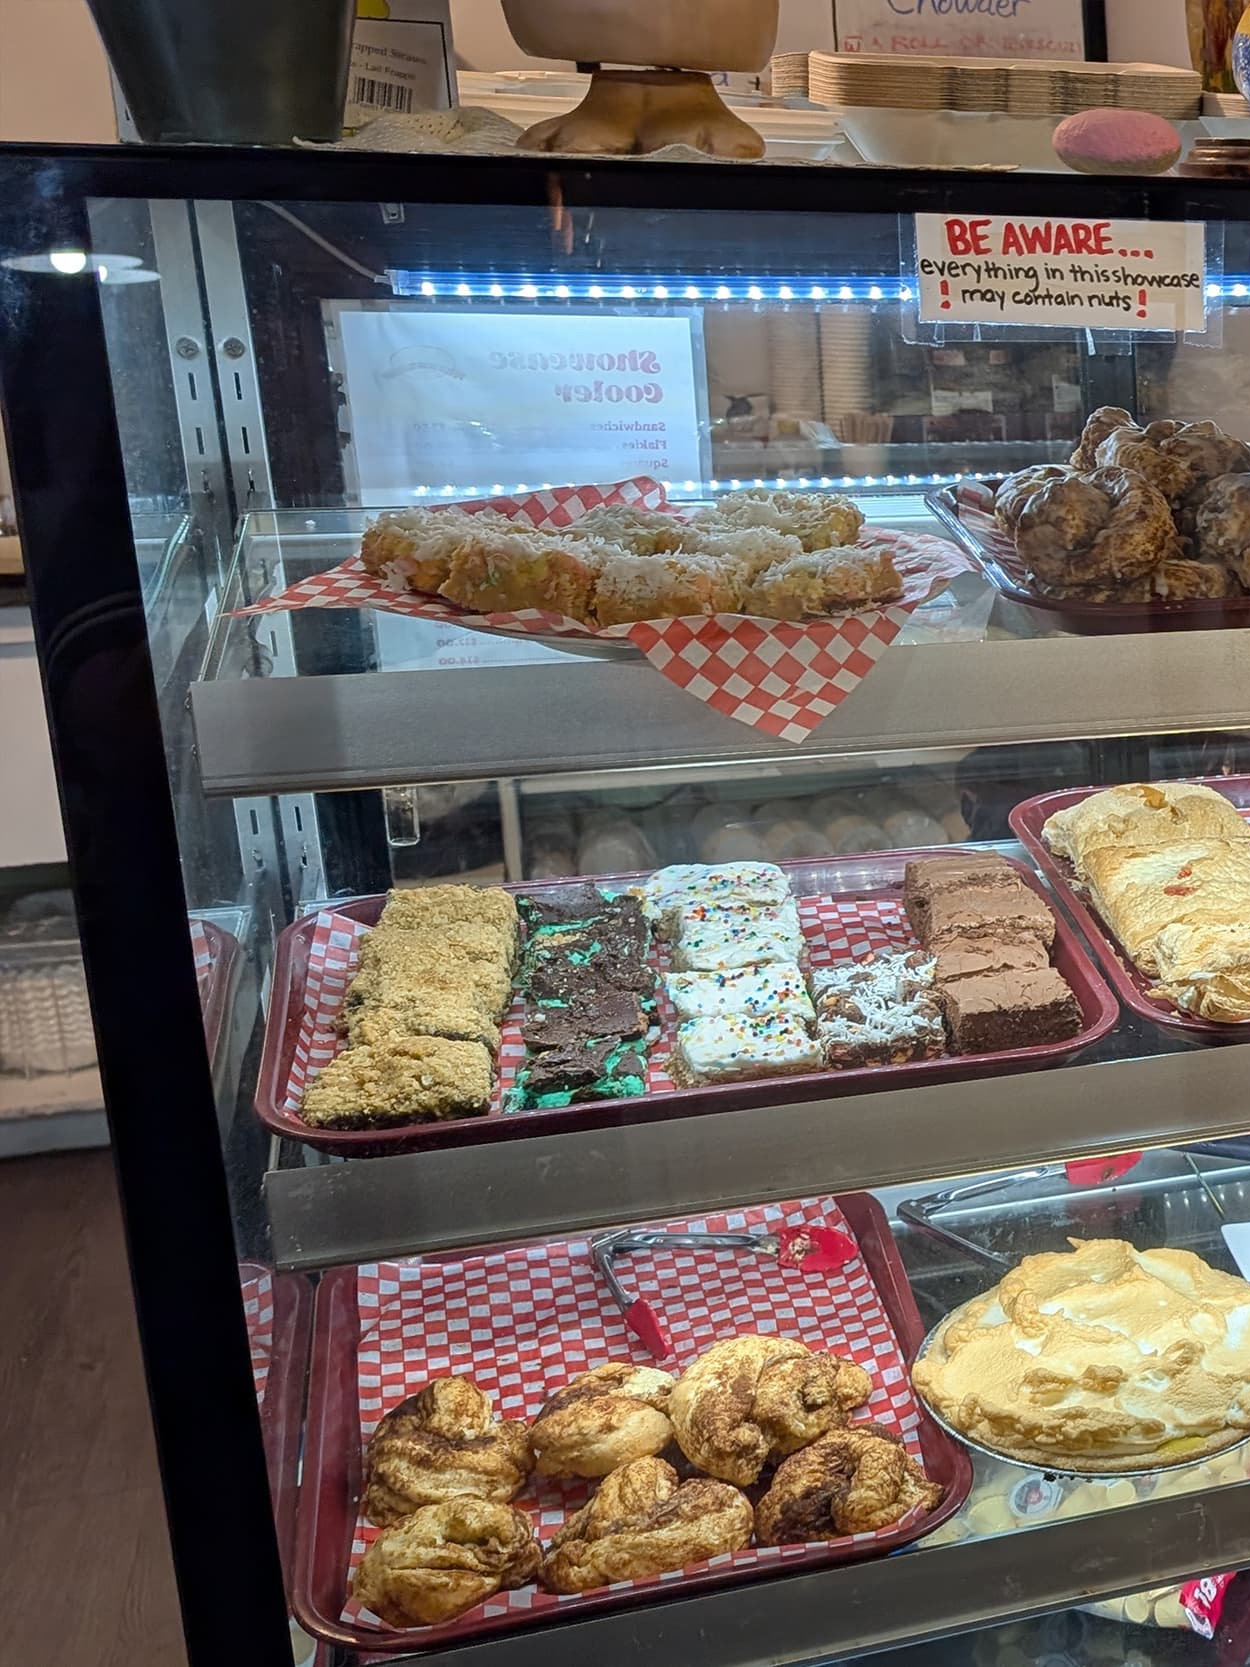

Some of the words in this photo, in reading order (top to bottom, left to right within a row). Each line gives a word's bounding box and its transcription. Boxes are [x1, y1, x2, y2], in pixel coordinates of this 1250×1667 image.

[944, 218, 993, 256] BE
[920, 258, 1039, 292] everything
[1044, 262, 1065, 281] in
[961, 287, 1005, 311] may
[1011, 287, 1083, 308] contain
